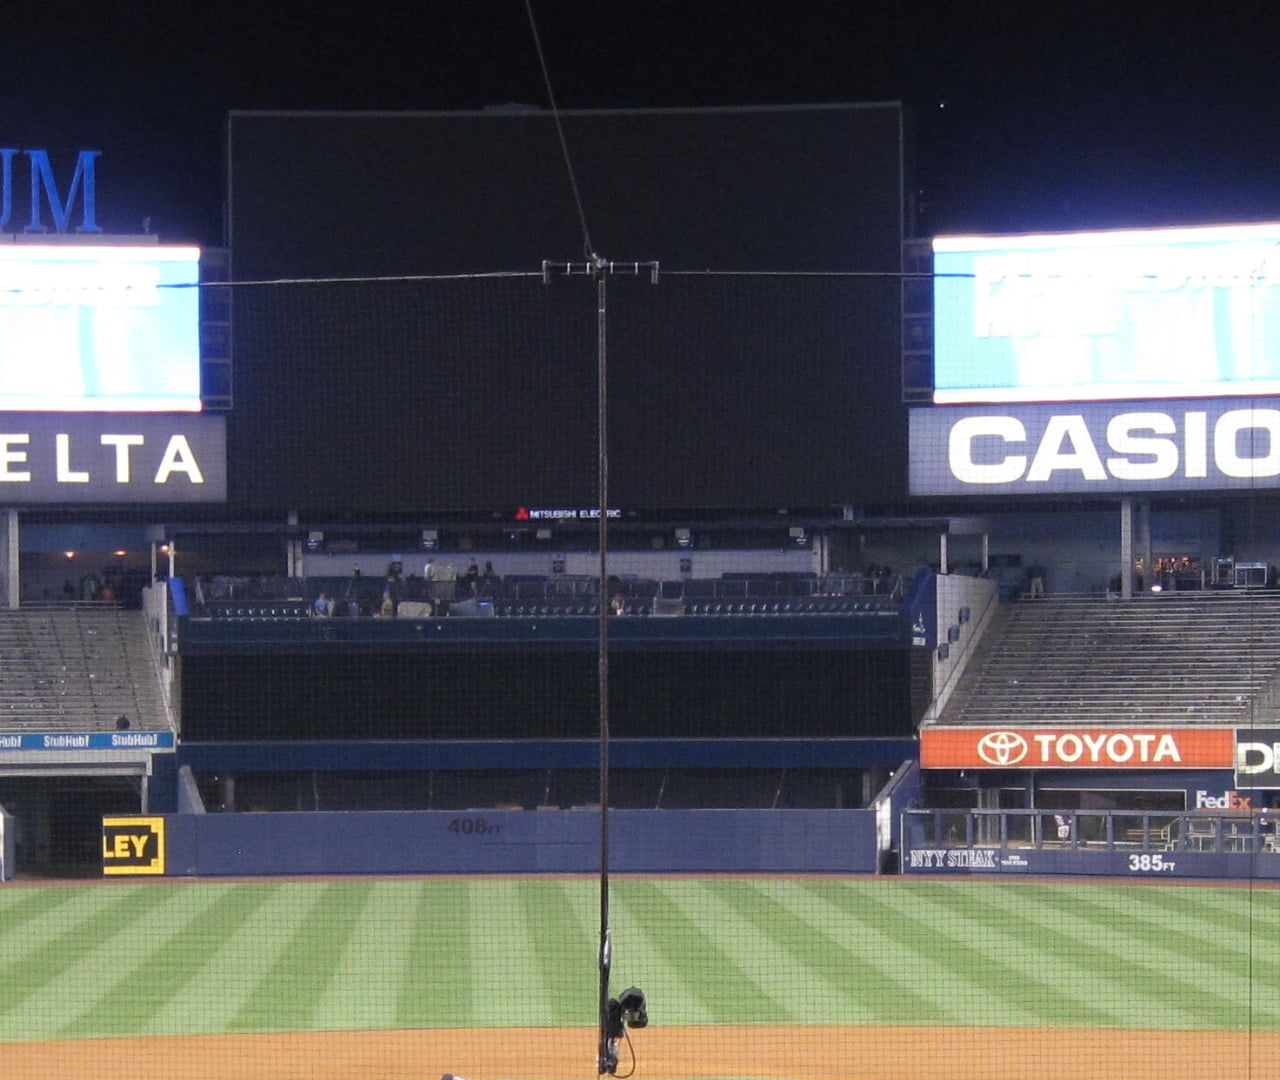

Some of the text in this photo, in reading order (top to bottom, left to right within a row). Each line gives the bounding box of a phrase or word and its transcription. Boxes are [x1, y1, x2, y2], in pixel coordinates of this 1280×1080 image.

[529, 509, 621, 519] MITSUBISHI ELECRIC
[1034, 733, 1182, 762] TOYOTA
[1195, 790, 1252, 810] FedEx
[909, 849, 996, 868] NYY STEAK
